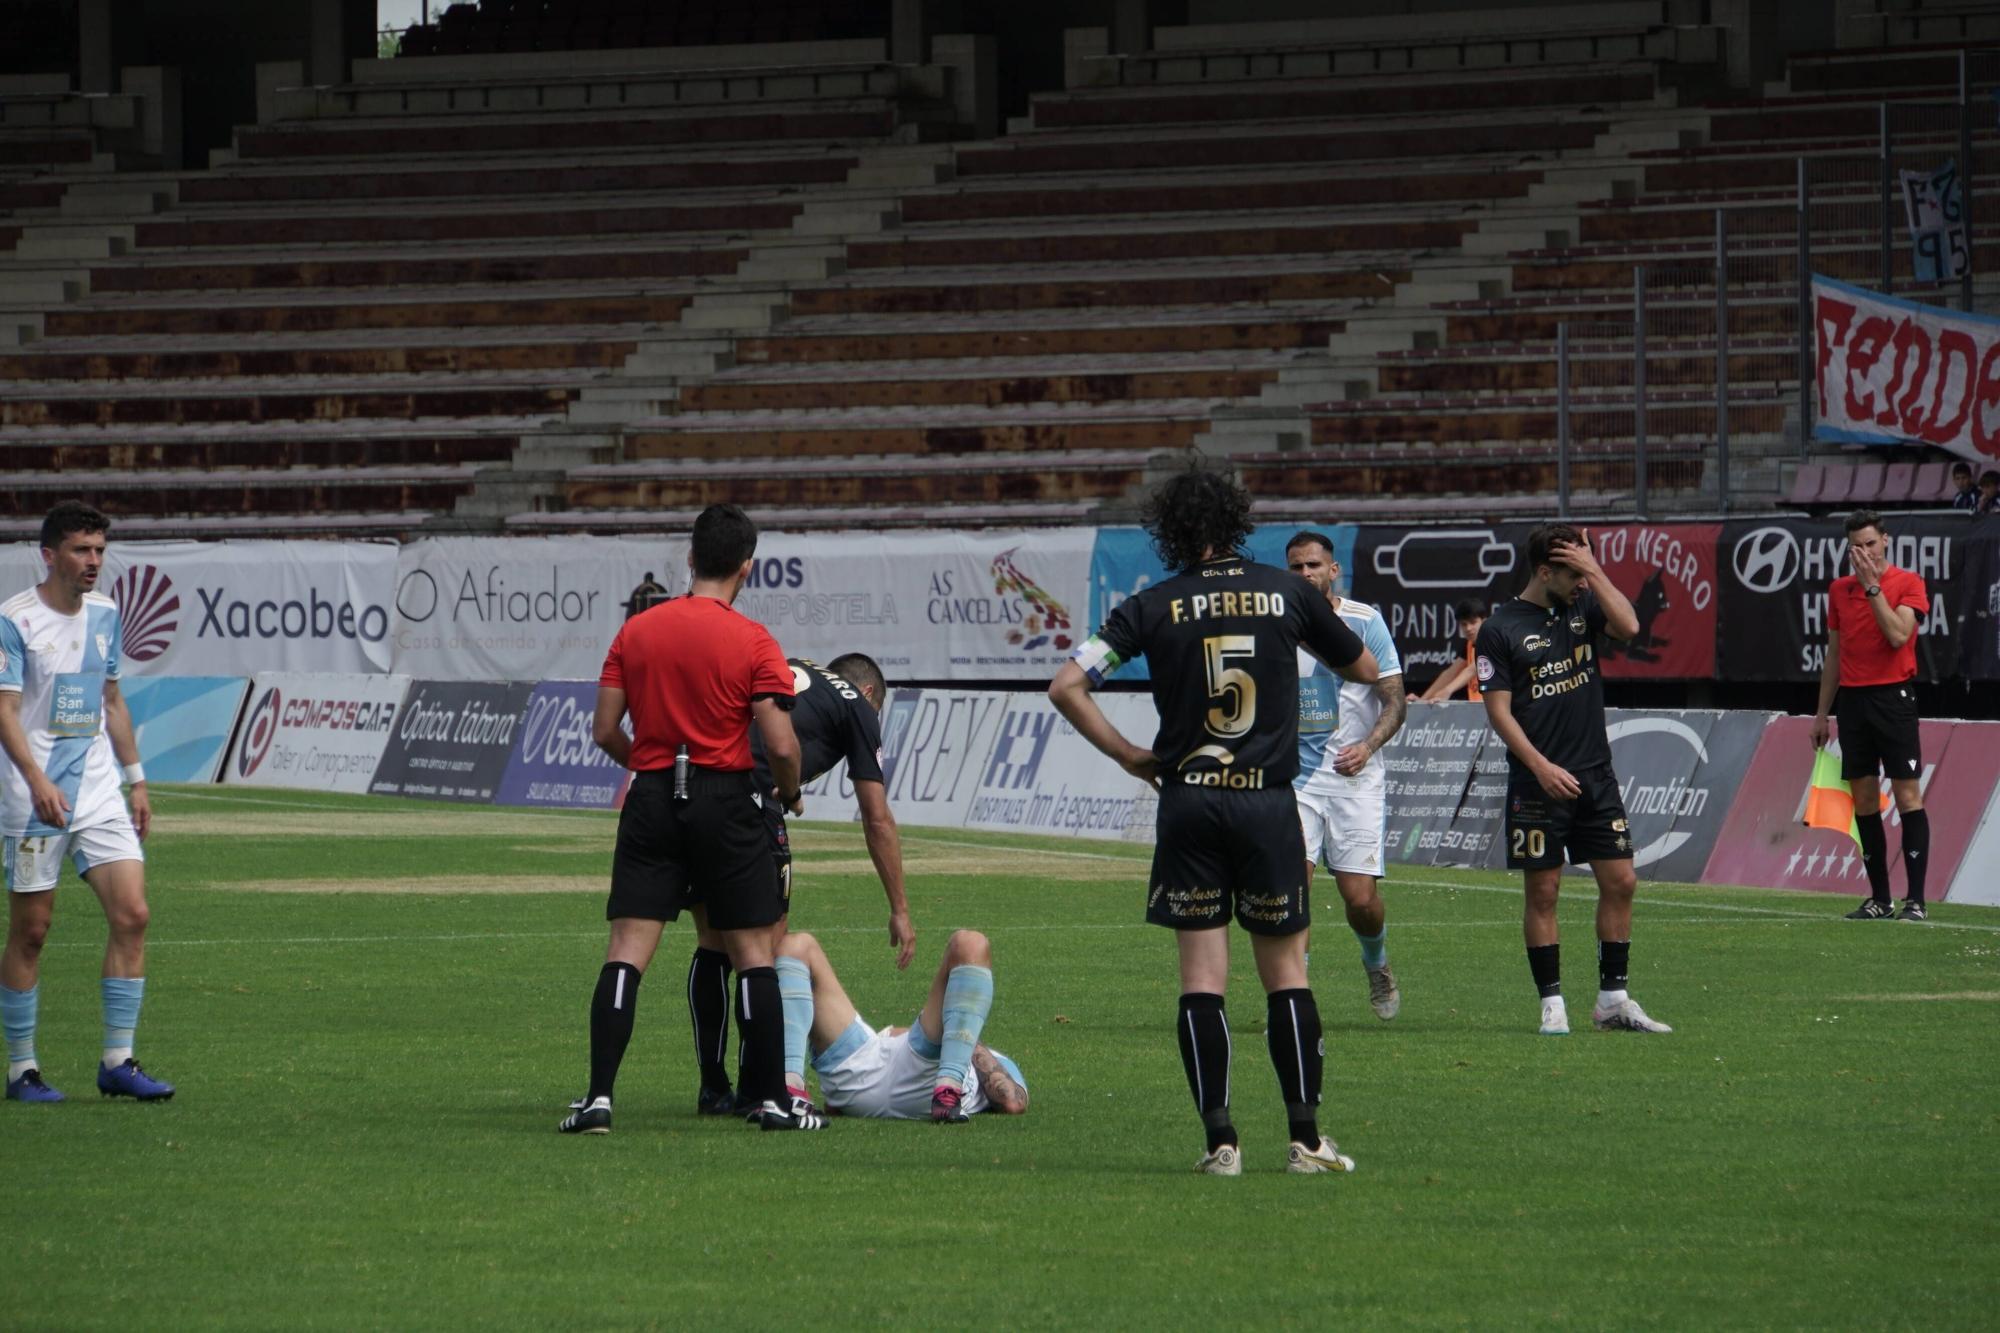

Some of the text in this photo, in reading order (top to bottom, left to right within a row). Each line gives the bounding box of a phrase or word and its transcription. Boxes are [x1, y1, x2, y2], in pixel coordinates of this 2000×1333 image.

[1635, 527, 1712, 611] NEGRO
[1803, 536, 1951, 581] HYDAI
[396, 564, 600, 623] O Afiador
[928, 569, 953, 597] AS
[196, 586, 388, 642] Xacobeo
[926, 597, 1024, 625] CANCELAS
[1191, 591, 1285, 620] PEREDO
[1391, 602, 1438, 639] PAN
[397, 629, 441, 649] Casa
[450, 631, 472, 649] de
[475, 632, 536, 649] comida
[559, 634, 600, 649] vinos
[1529, 657, 1573, 681] Feten
[57, 685, 84, 695] Cobre
[1203, 635, 1256, 739] 5
[1298, 687, 1319, 696] obre
[1531, 671, 1590, 699] Domun
[56, 695, 84, 710] San
[281, 698, 396, 732] COMPOSCAR
[55, 711, 95, 724] Rafael
[1405, 721, 1466, 748] vehículos
[1425, 757, 1470, 777] Recogemos
[1628, 776, 1709, 817] motion
[1512, 828, 1547, 859] 20
